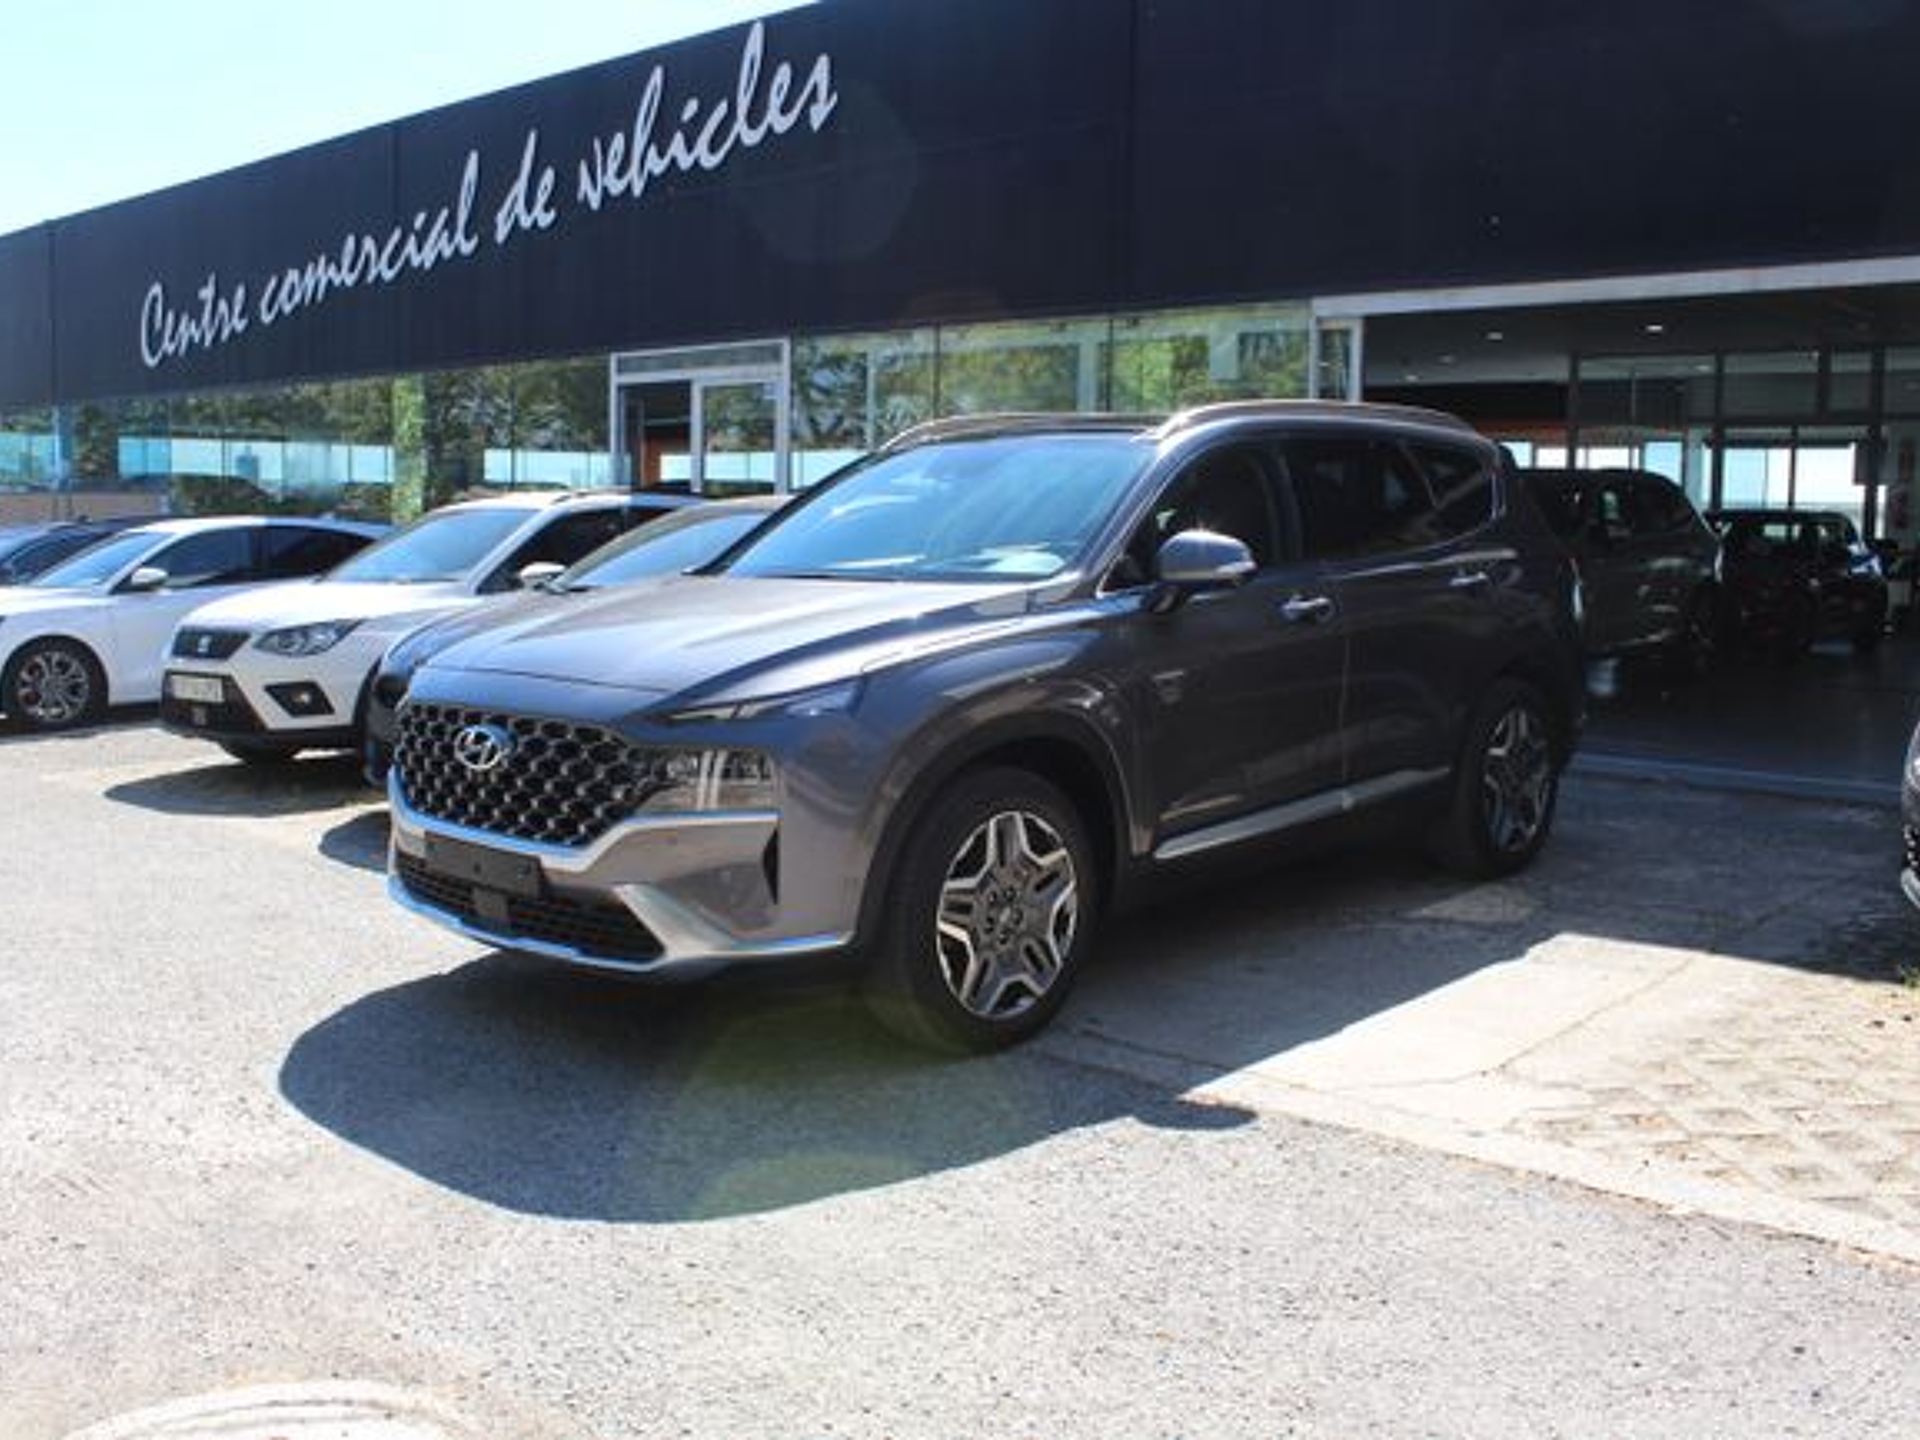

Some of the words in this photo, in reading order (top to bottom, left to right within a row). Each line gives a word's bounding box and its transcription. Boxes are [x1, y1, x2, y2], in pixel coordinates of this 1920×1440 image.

[140, 273, 248, 368] Centre
[260, 150, 479, 324] comercial
[495, 130, 556, 244] de
[577, 20, 838, 210] vehicles
